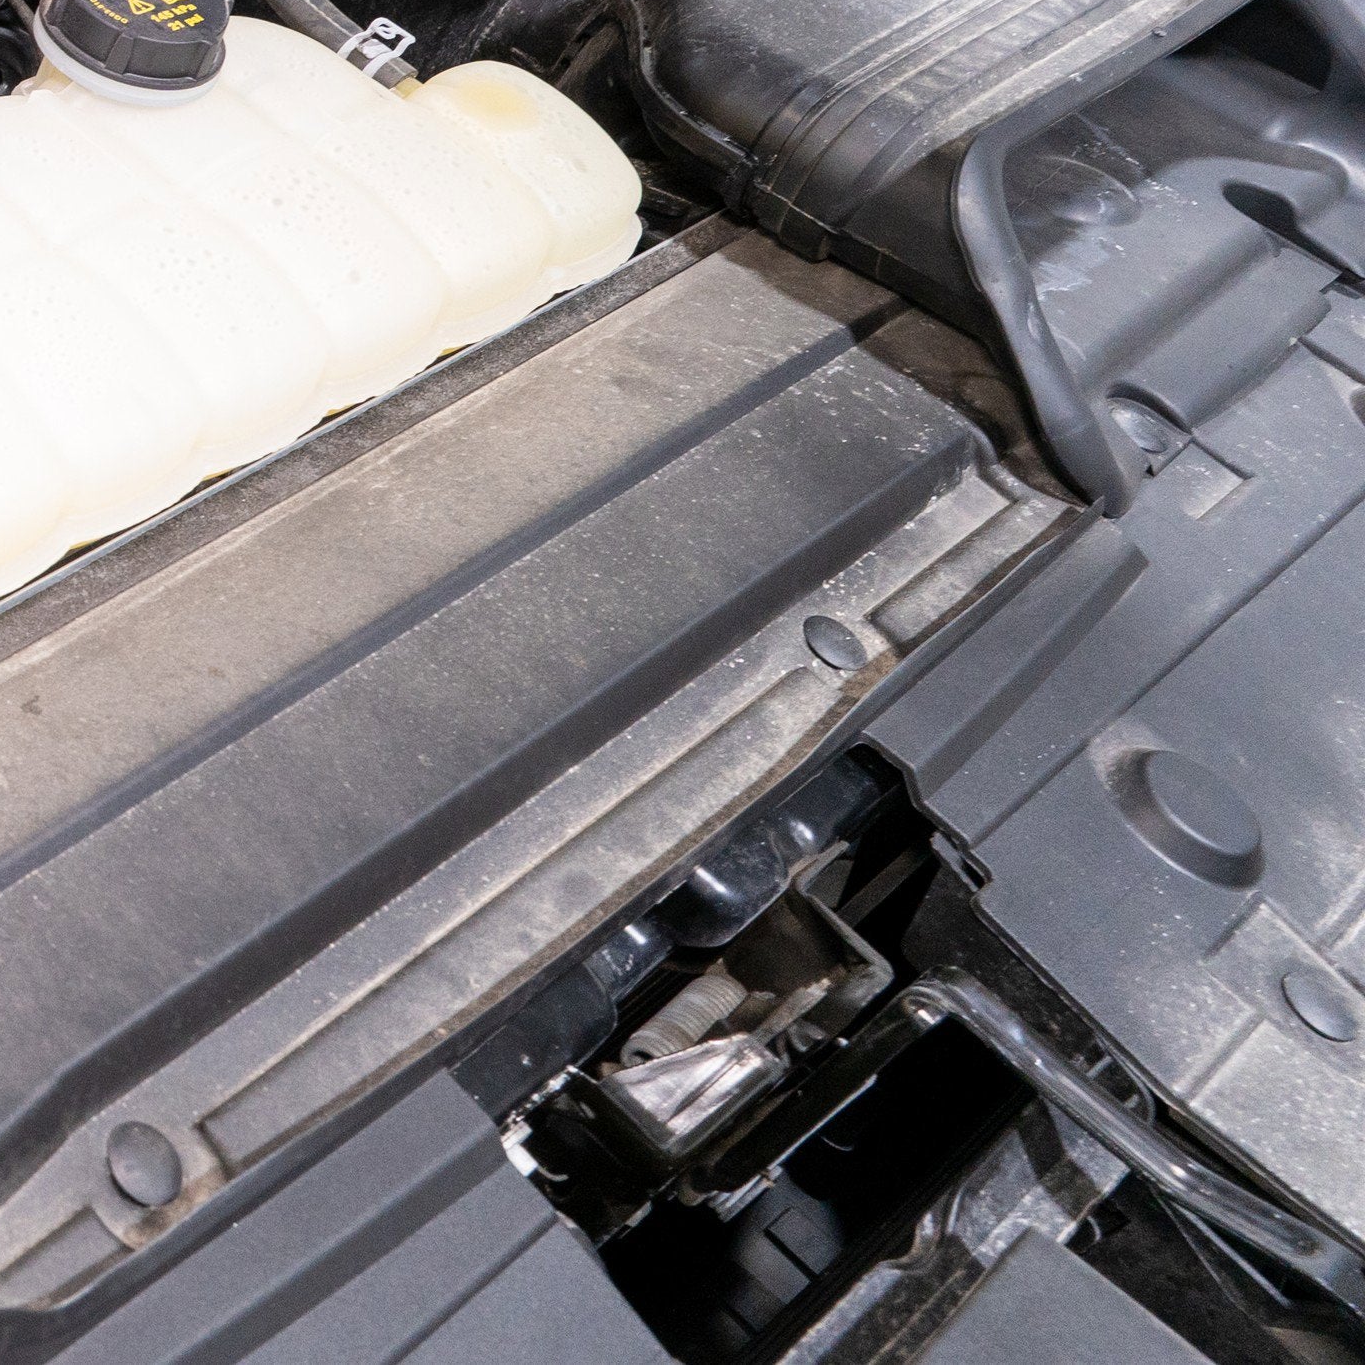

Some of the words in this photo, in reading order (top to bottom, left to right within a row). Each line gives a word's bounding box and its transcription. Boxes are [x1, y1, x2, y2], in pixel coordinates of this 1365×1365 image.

[150, 7, 175, 23] 145
[171, 3, 198, 17] kPa
[167, 20, 185, 31] 21
[183, 13, 205, 27] psi
